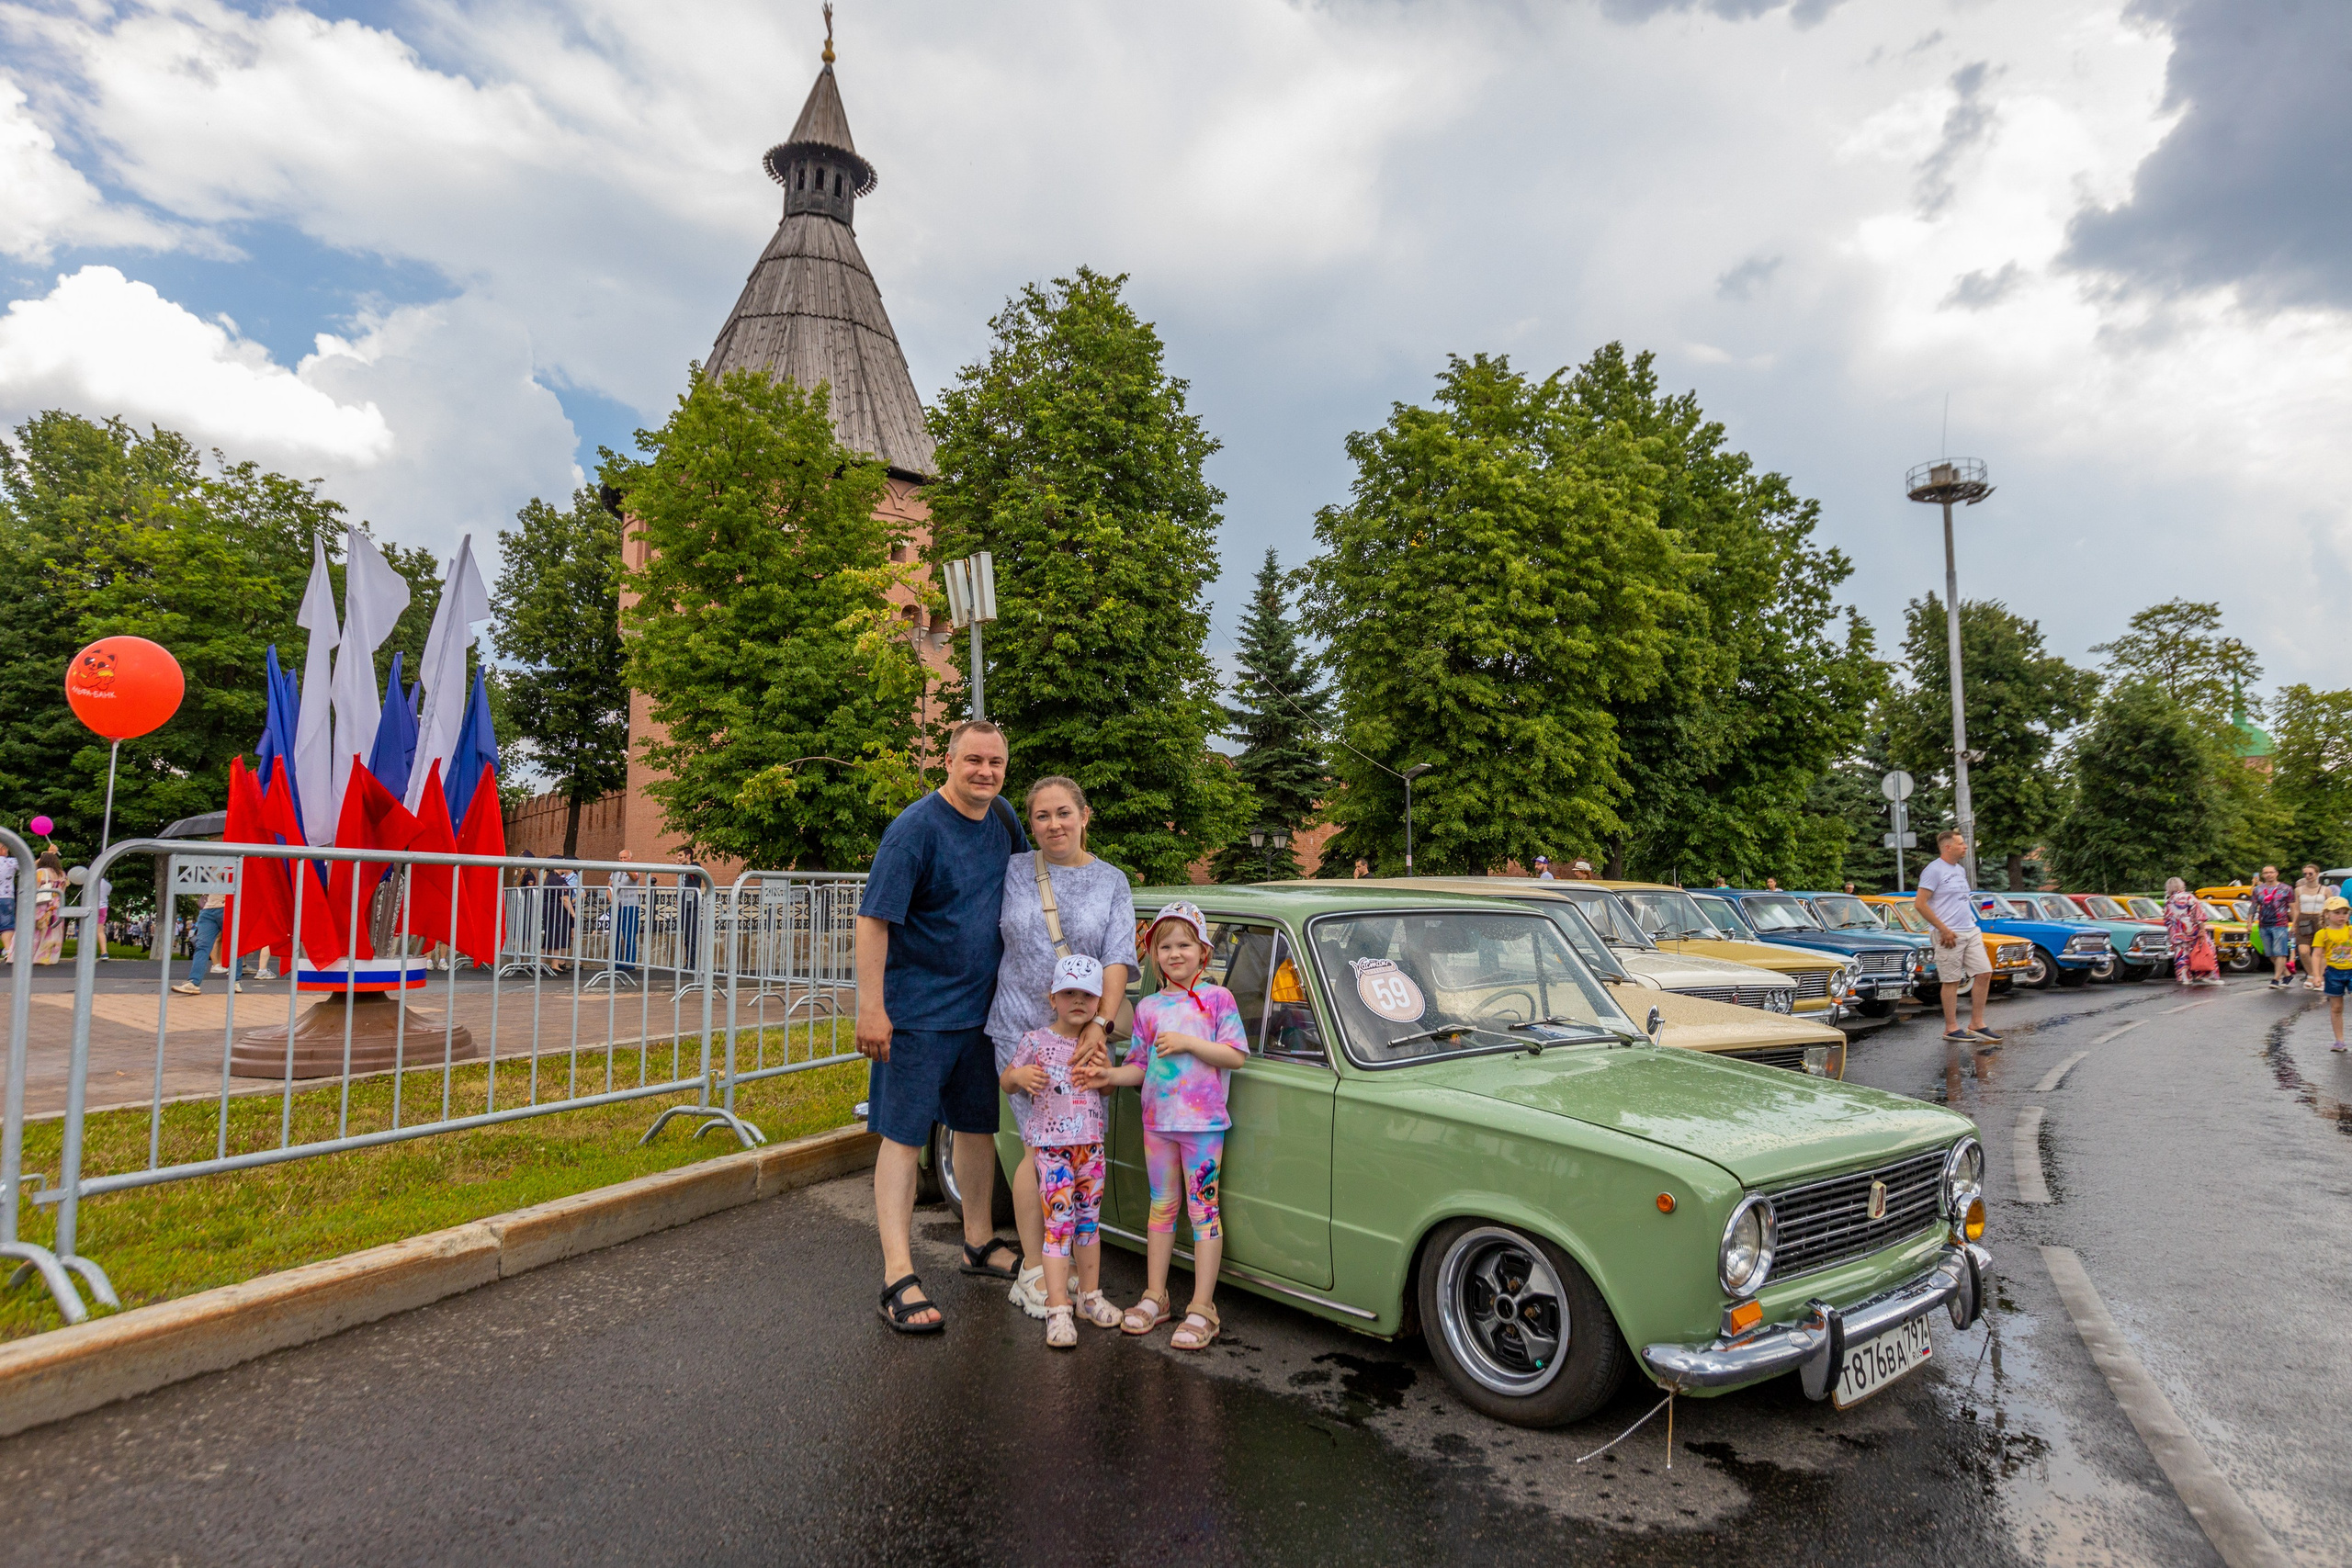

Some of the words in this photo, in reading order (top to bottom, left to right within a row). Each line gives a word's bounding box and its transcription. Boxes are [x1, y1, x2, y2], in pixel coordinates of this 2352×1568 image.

[1372, 976, 1410, 1010] 59
[1904, 1316, 1925, 1353] 797
[1912, 1348, 1923, 1360] RUS
